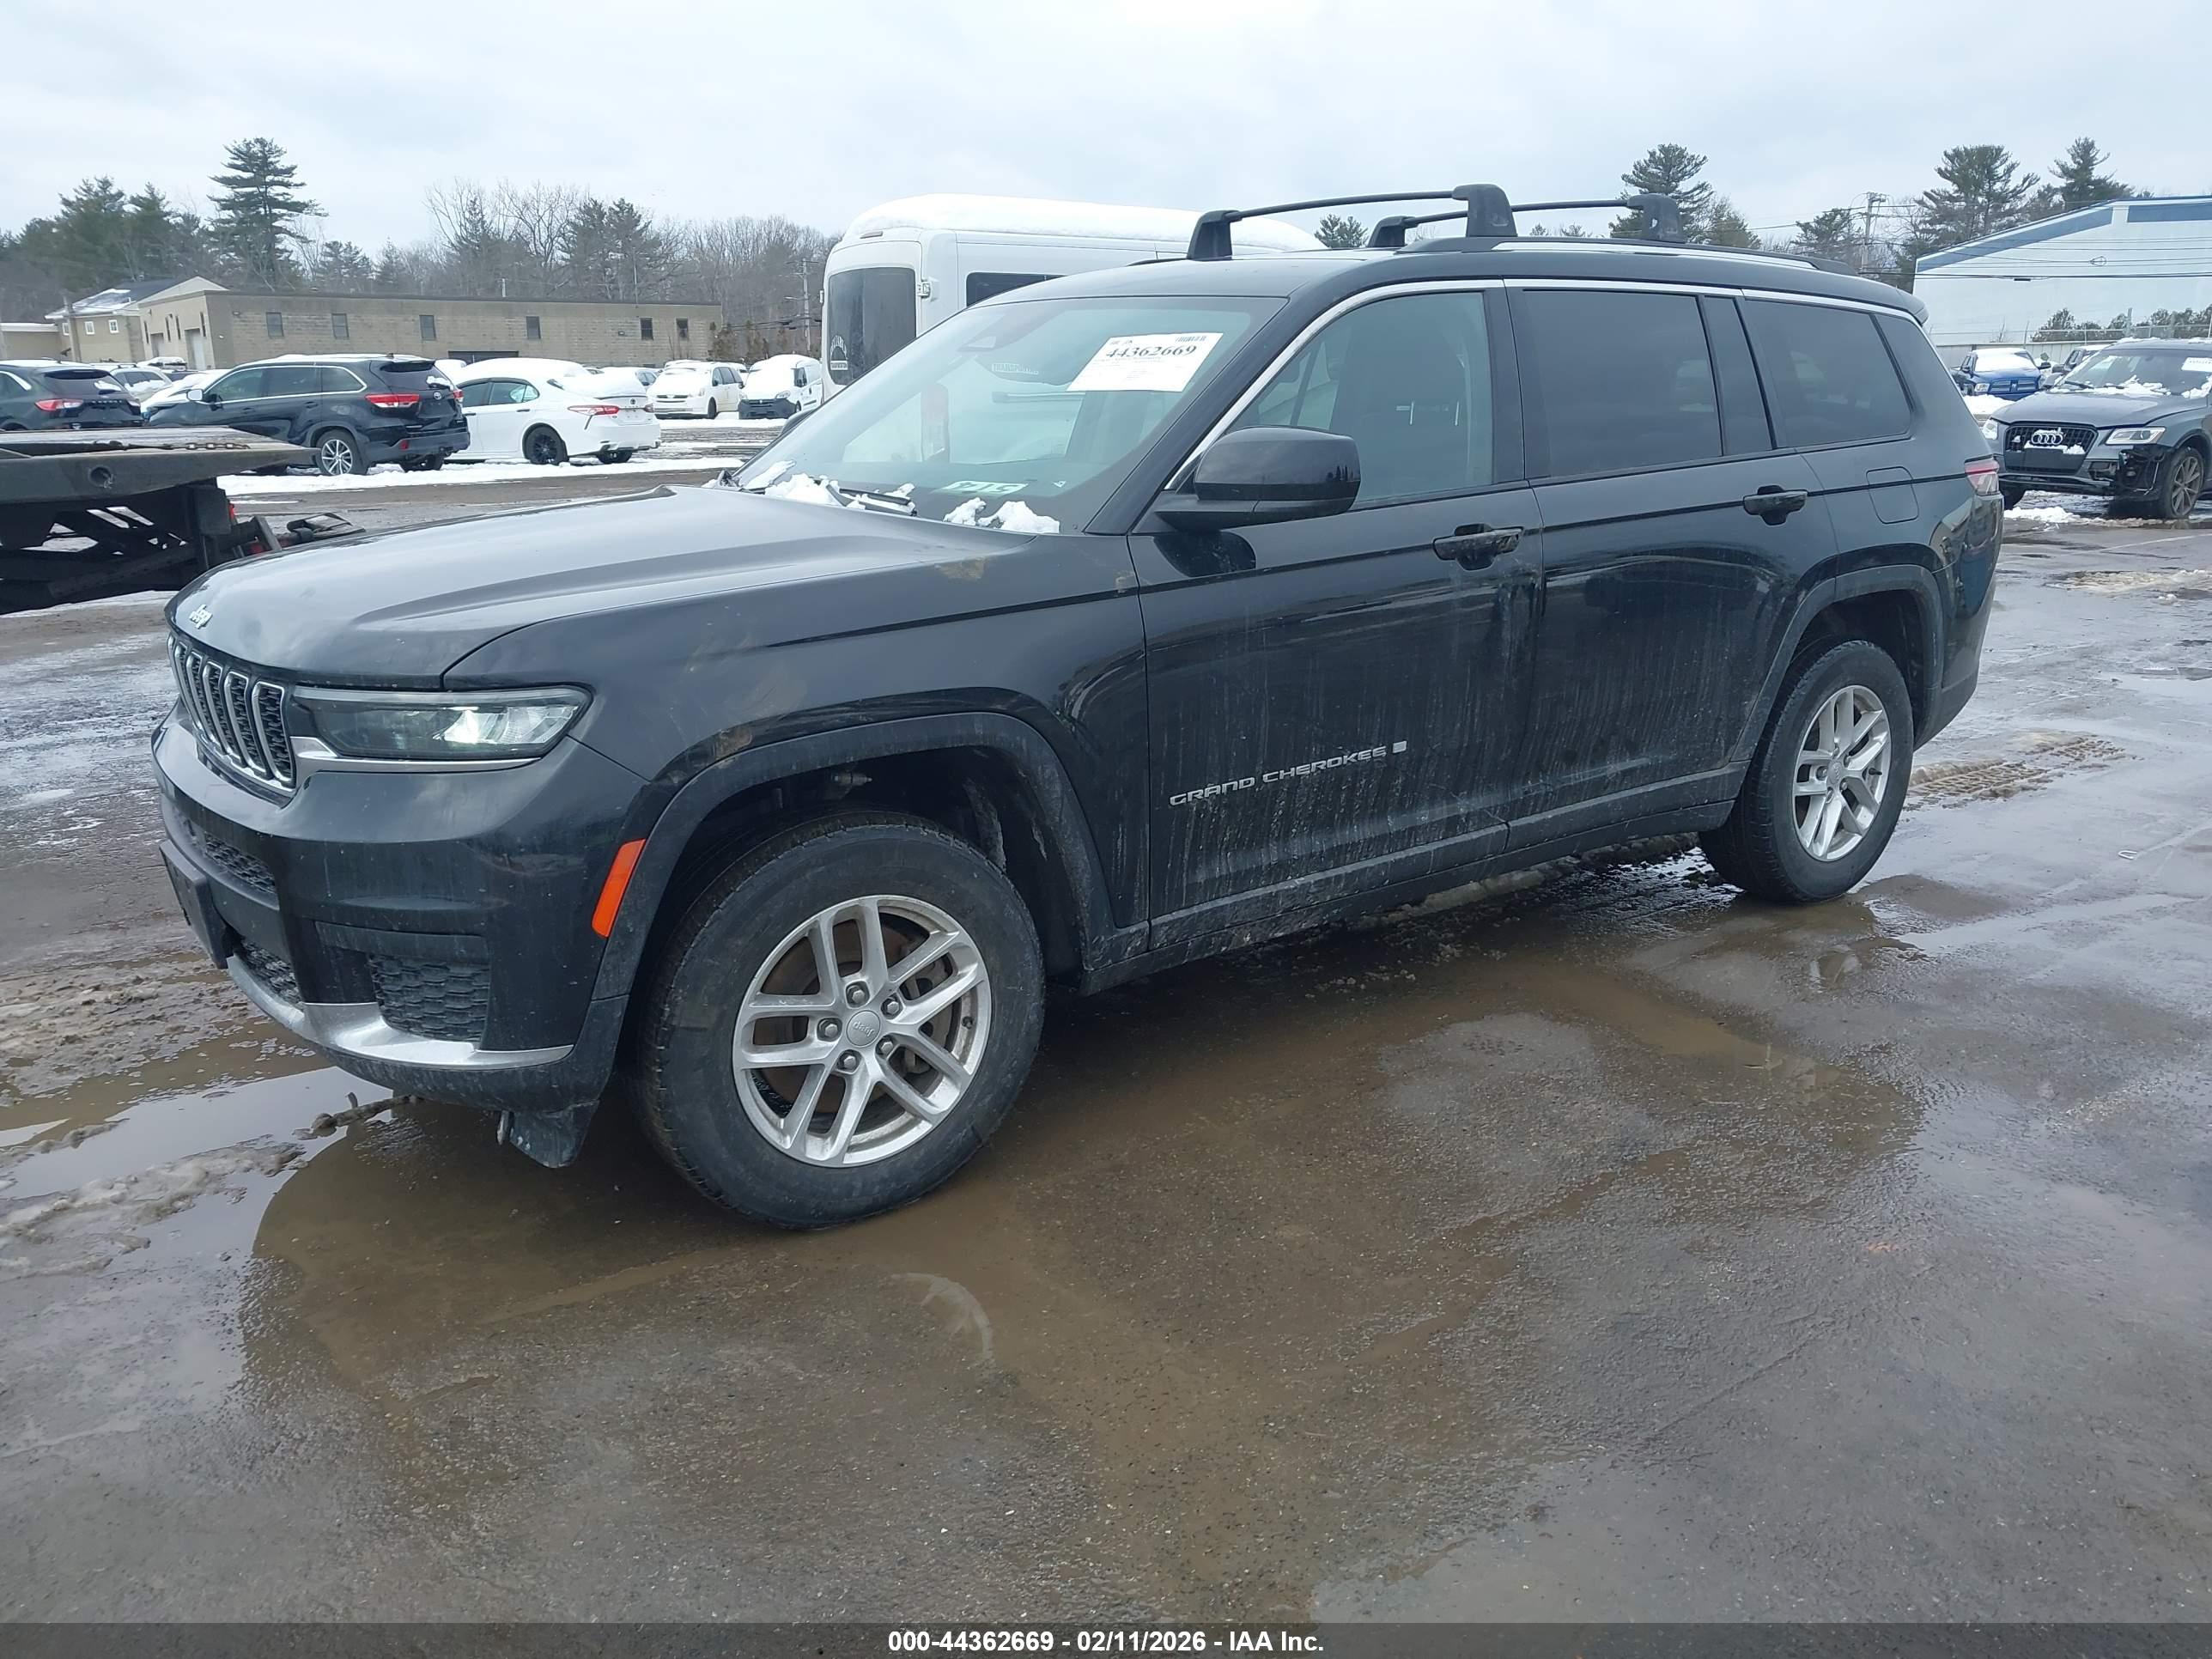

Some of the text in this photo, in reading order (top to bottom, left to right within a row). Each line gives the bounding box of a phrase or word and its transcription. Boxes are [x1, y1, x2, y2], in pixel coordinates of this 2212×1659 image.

[1106, 345, 1197, 358] 44362669
[1169, 744, 1388, 806] GRAND CHEROKEE
